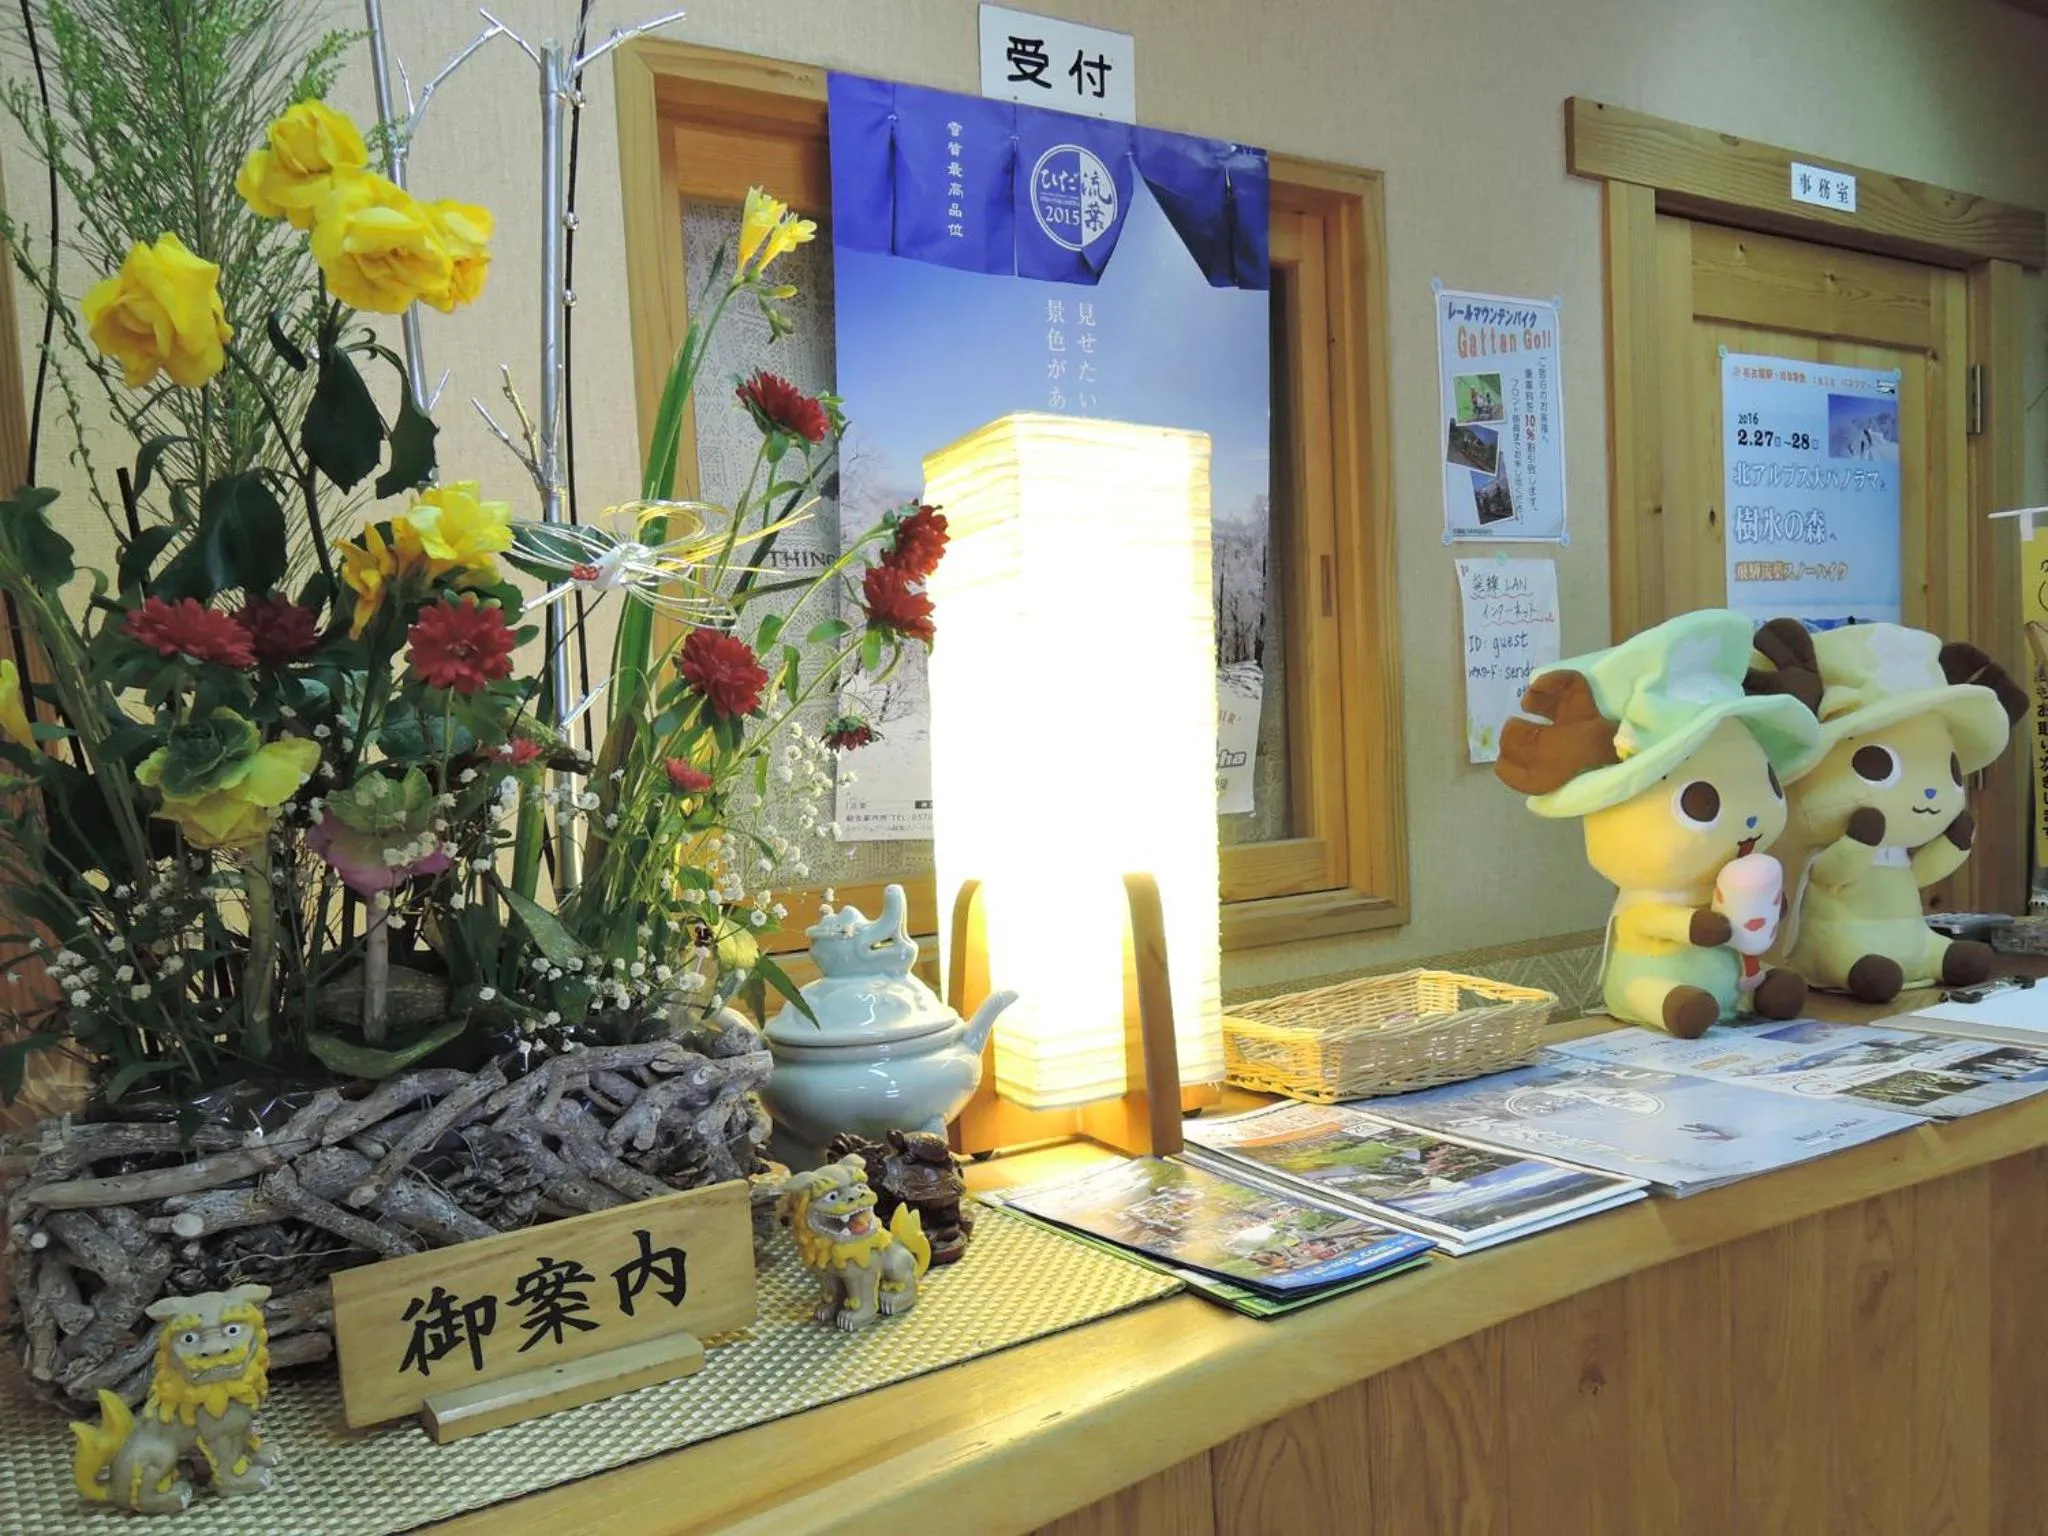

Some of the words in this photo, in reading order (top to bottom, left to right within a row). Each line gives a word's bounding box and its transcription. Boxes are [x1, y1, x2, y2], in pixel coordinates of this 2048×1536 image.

[1007, 36, 1112, 98] 受付
[1082, 171, 1112, 232] 流葉
[1799, 172, 1849, 204] 事務室
[1045, 205, 1080, 226] 2015
[1448, 301, 1537, 329] レールマウンテンバイク
[1046, 299, 1067, 409] 景色があ
[1457, 325, 1517, 359] Gattan
[1077, 302, 1098, 417] 見せたい
[1738, 412, 1759, 425] 2016
[1505, 576, 1527, 591] LAN
[1483, 601, 1539, 620] インターネット
[1493, 630, 1528, 658] guest
[1505, 660, 1533, 680] send
[398, 1229, 688, 1376] 御案内
